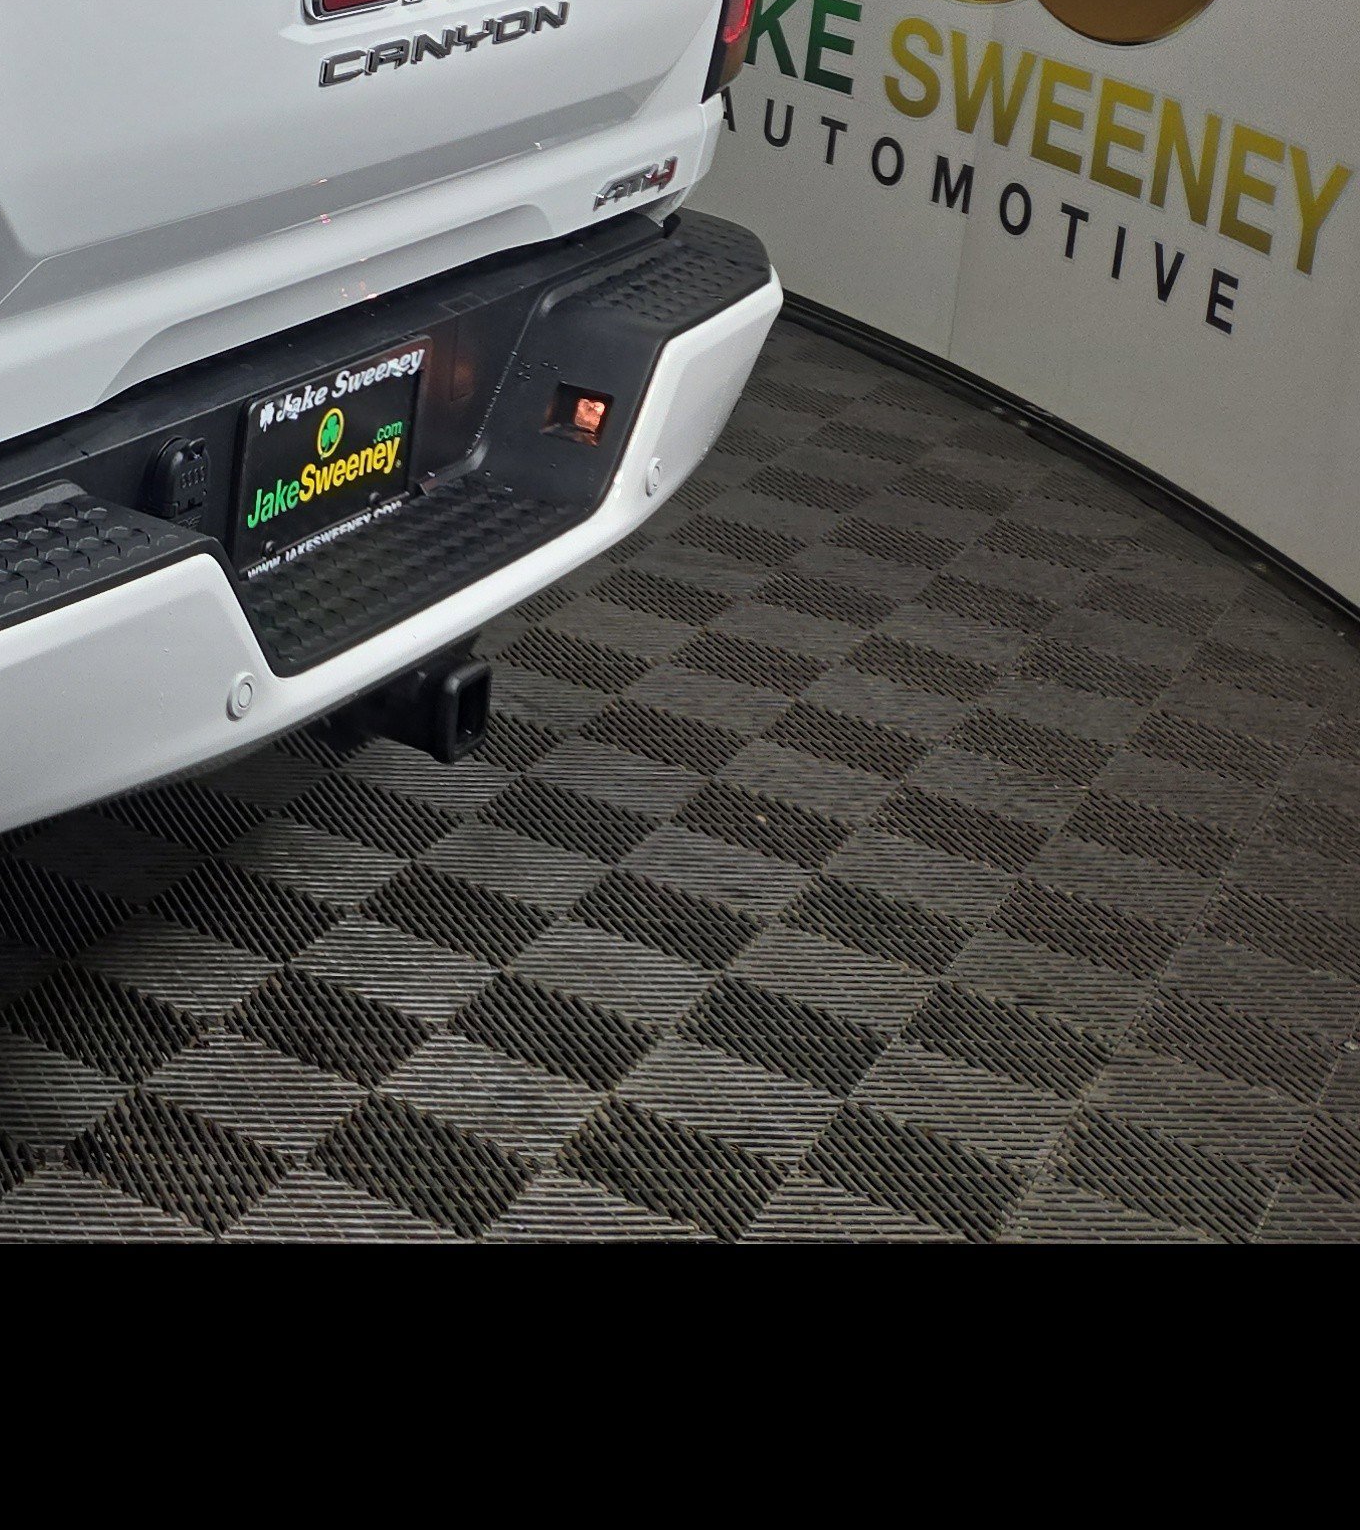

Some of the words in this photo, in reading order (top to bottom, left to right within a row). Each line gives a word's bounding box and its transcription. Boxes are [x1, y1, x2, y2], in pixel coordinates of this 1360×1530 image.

[319, 1, 569, 88] CANYON
[593, 156, 678, 211] AT4
[884, 16, 1354, 276] SWEENEY
[276, 385, 328, 422] Jake
[331, 349, 425, 398] Sweeney
[373, 420, 402, 444] .com
[247, 437, 401, 529] JakeSweeney
